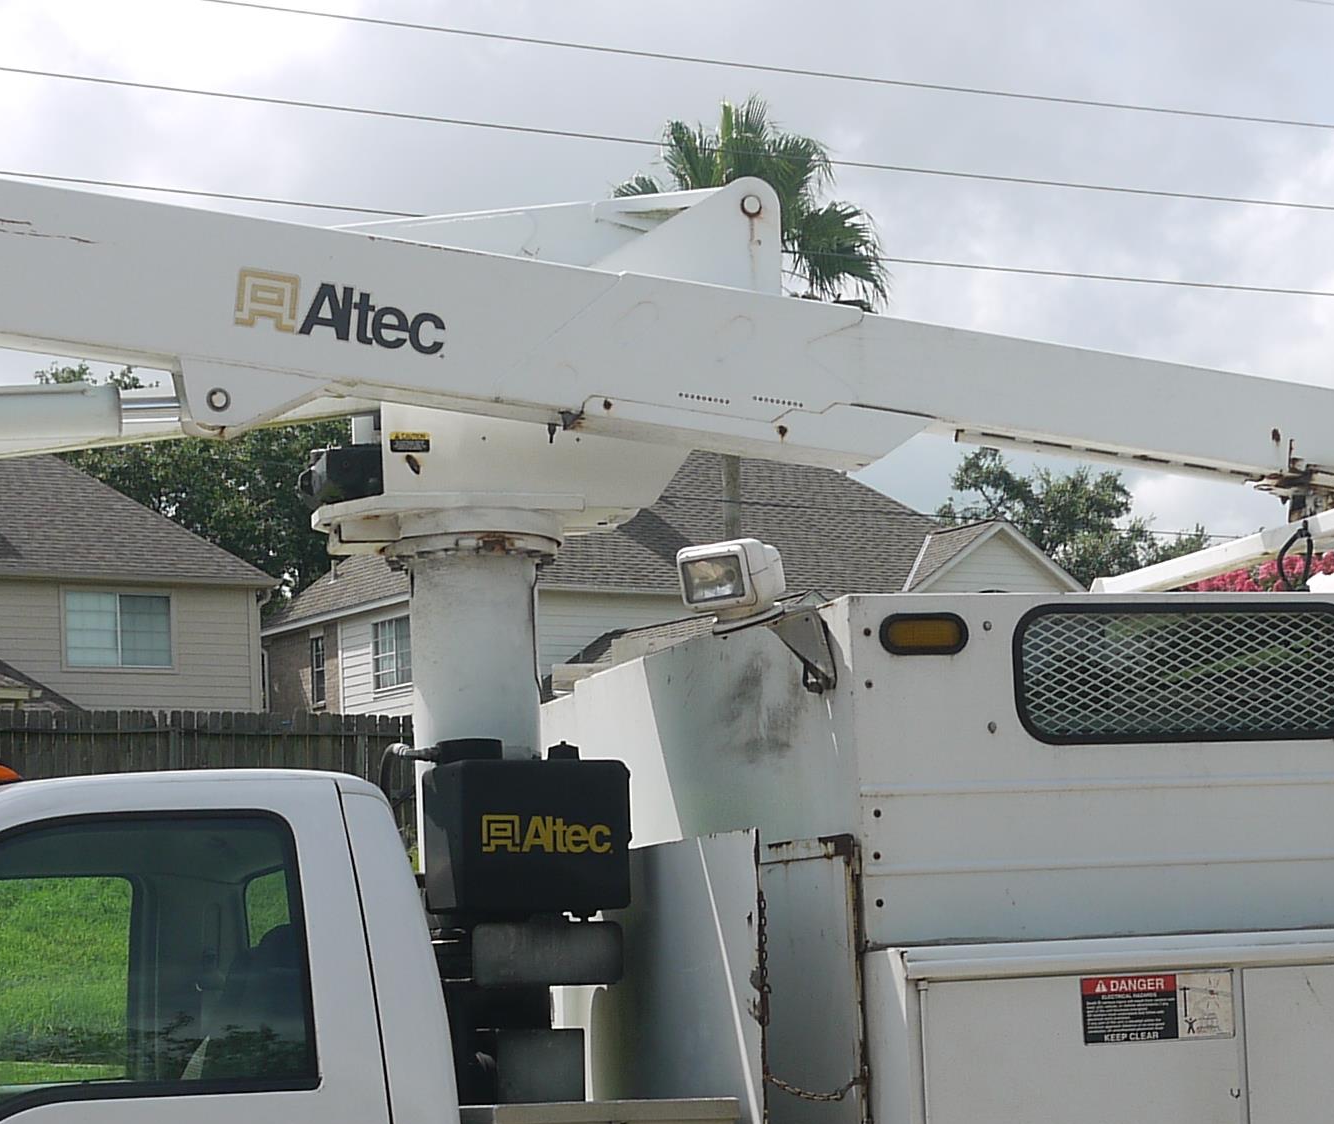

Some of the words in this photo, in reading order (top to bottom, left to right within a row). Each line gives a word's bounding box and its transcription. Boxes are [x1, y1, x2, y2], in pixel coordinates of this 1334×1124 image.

[299, 282, 446, 355] Altec
[521, 815, 612, 853] Altec
[1110, 978, 1164, 992] DANGER
[1104, 1032, 1127, 1042] KEEP
[1129, 1031, 1160, 1041] CLEAR
